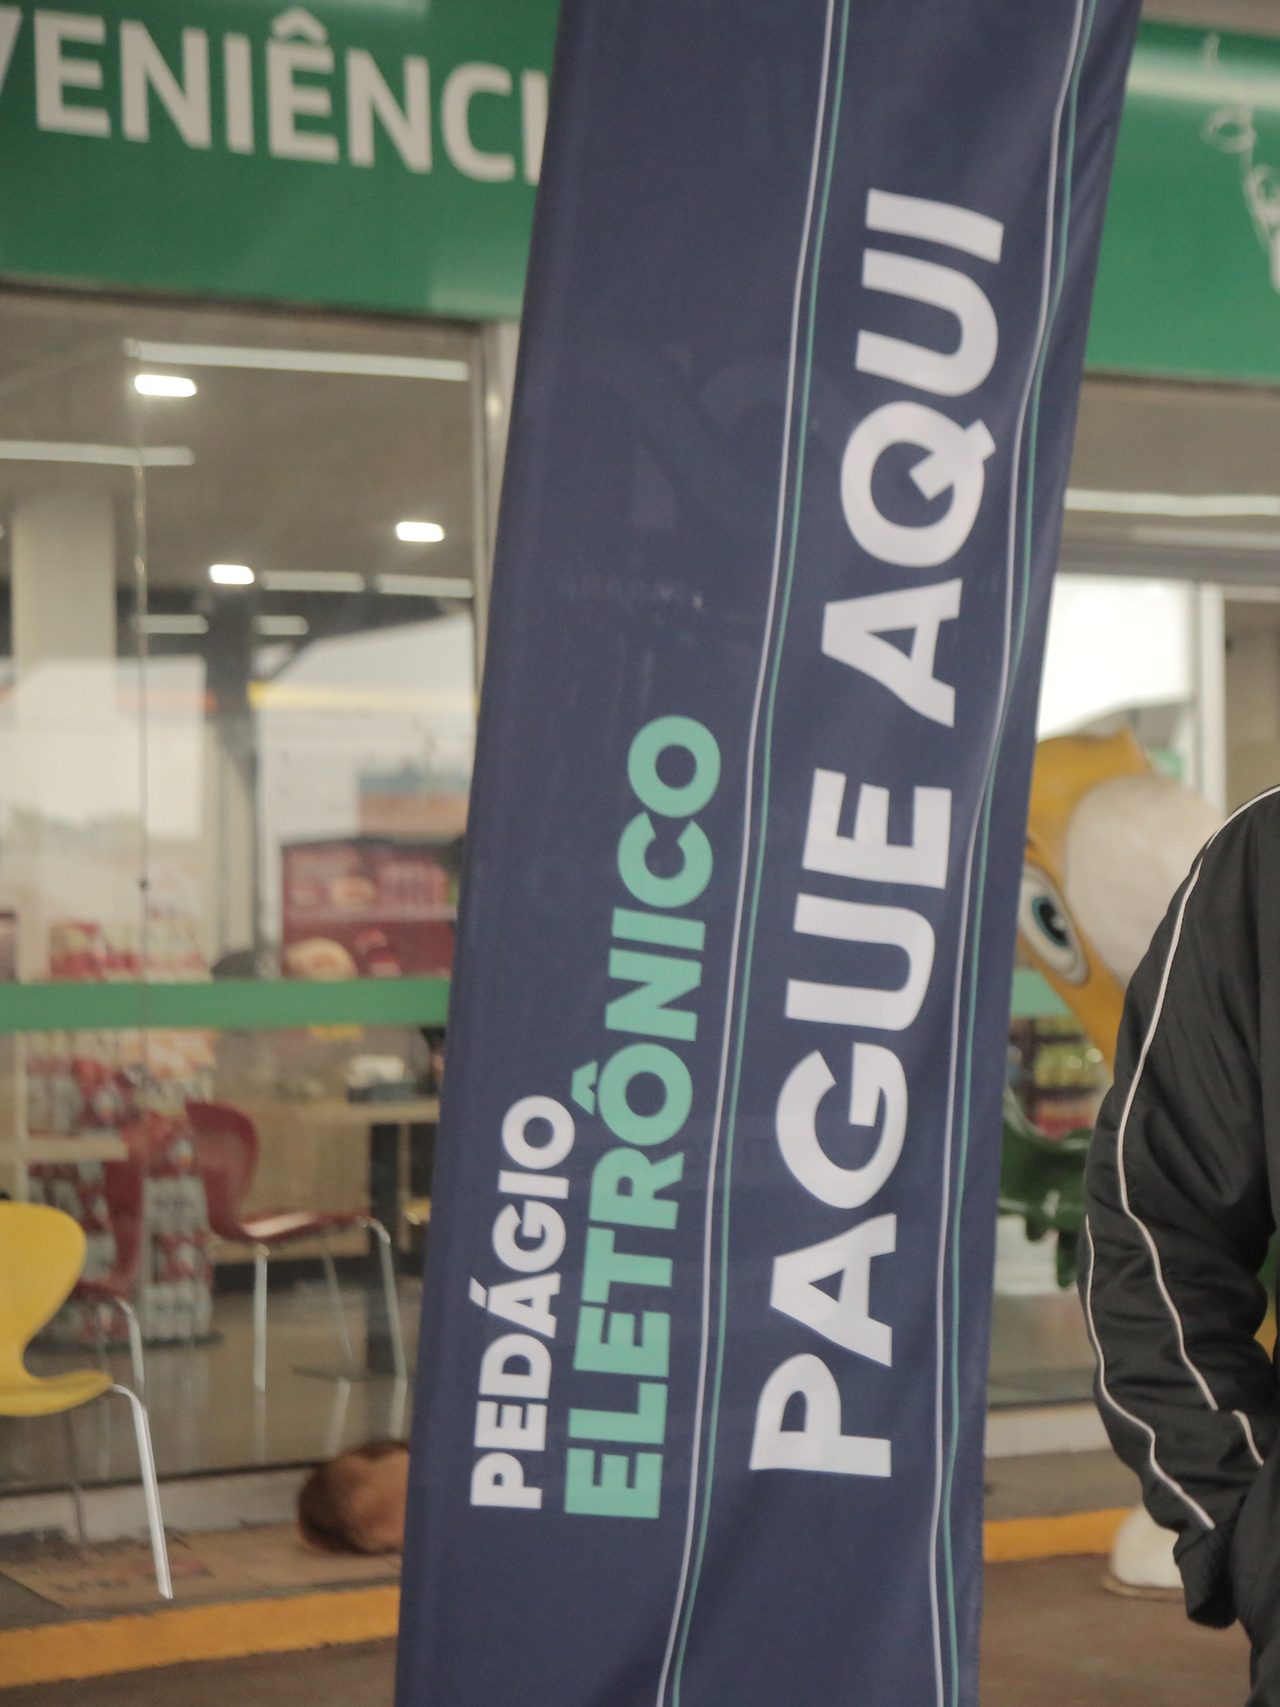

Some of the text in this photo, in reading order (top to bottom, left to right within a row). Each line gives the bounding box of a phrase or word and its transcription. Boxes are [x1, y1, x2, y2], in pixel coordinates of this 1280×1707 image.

[563, 715, 721, 1519] ELETRÔNICO
[748, 188, 1004, 1478] PAGUE AQUI
[469, 1095, 576, 1510] PEDÁGIO
